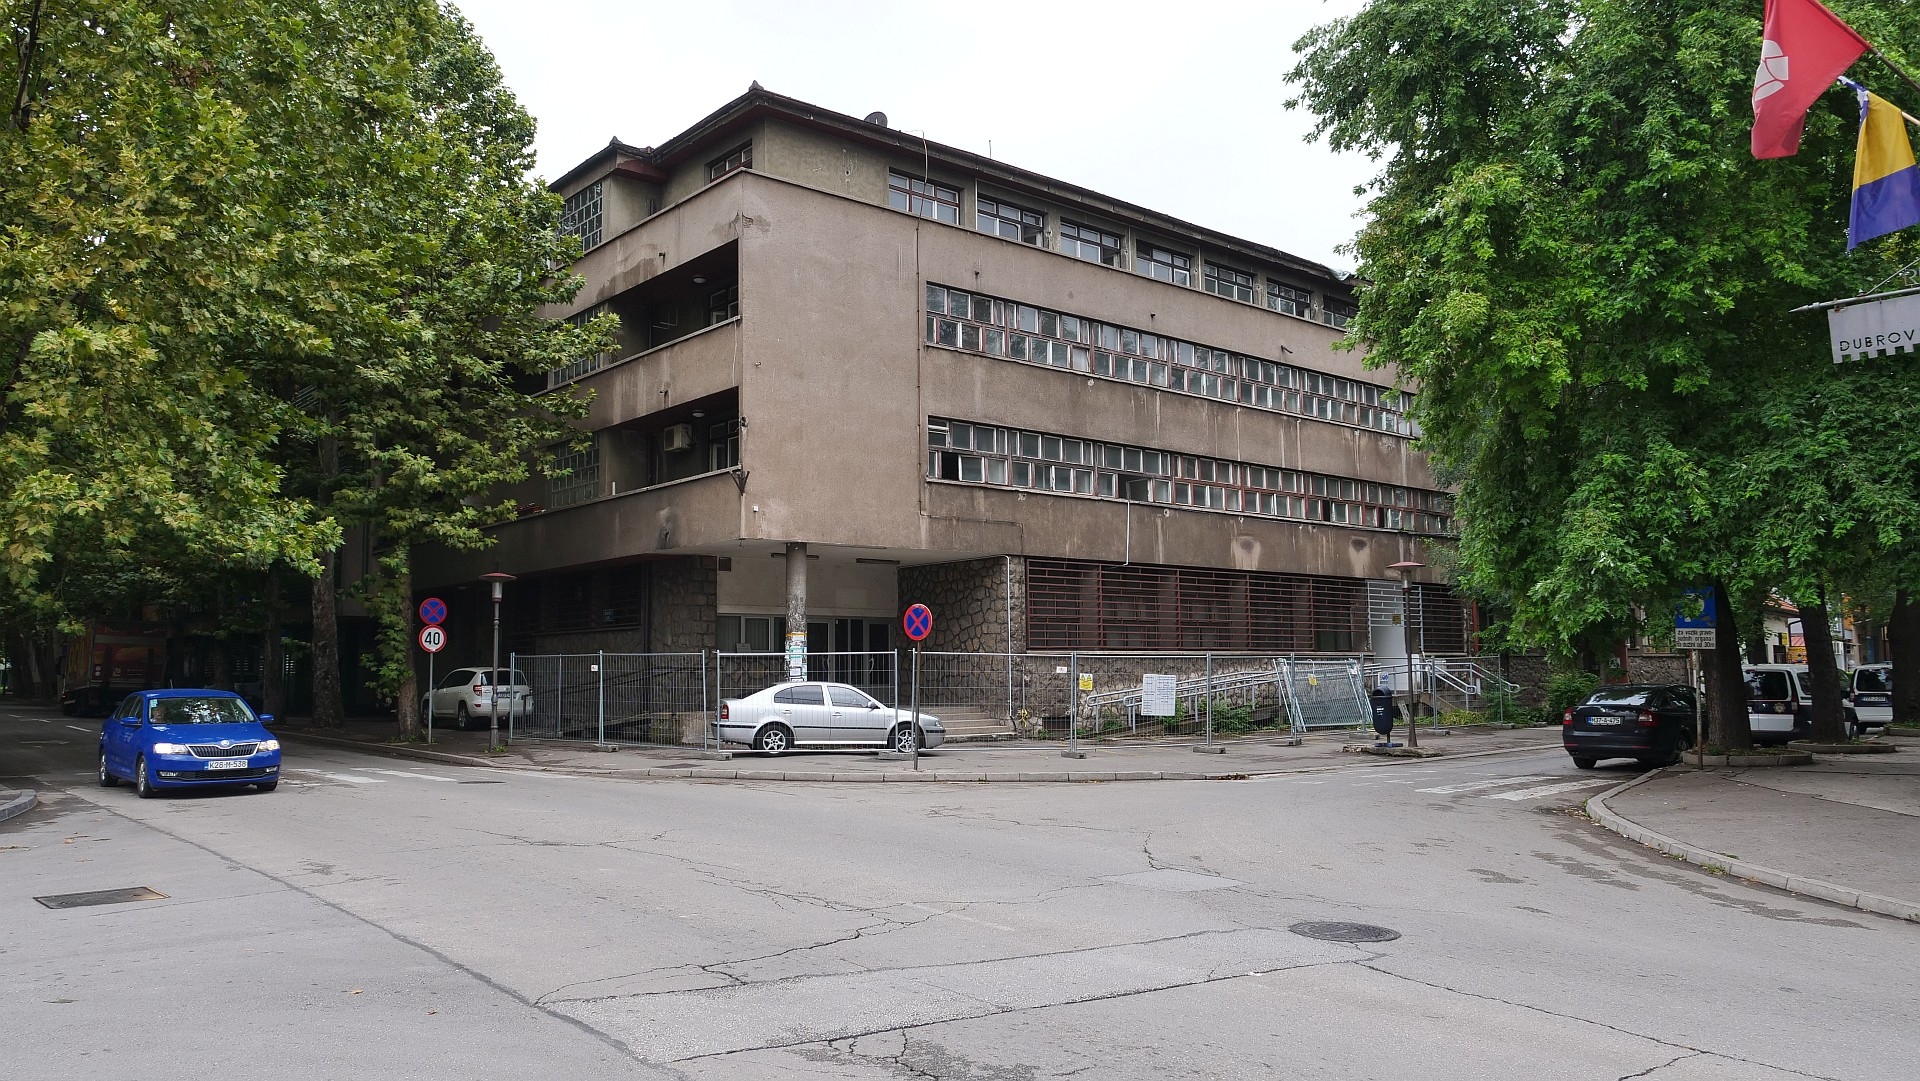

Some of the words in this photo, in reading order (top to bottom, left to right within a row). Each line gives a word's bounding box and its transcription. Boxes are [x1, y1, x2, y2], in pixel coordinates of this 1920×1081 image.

[1840, 329, 1920, 351] DUBROV
[424, 631, 440, 645] 40
[210, 761, 247, 769] K28-M-538
